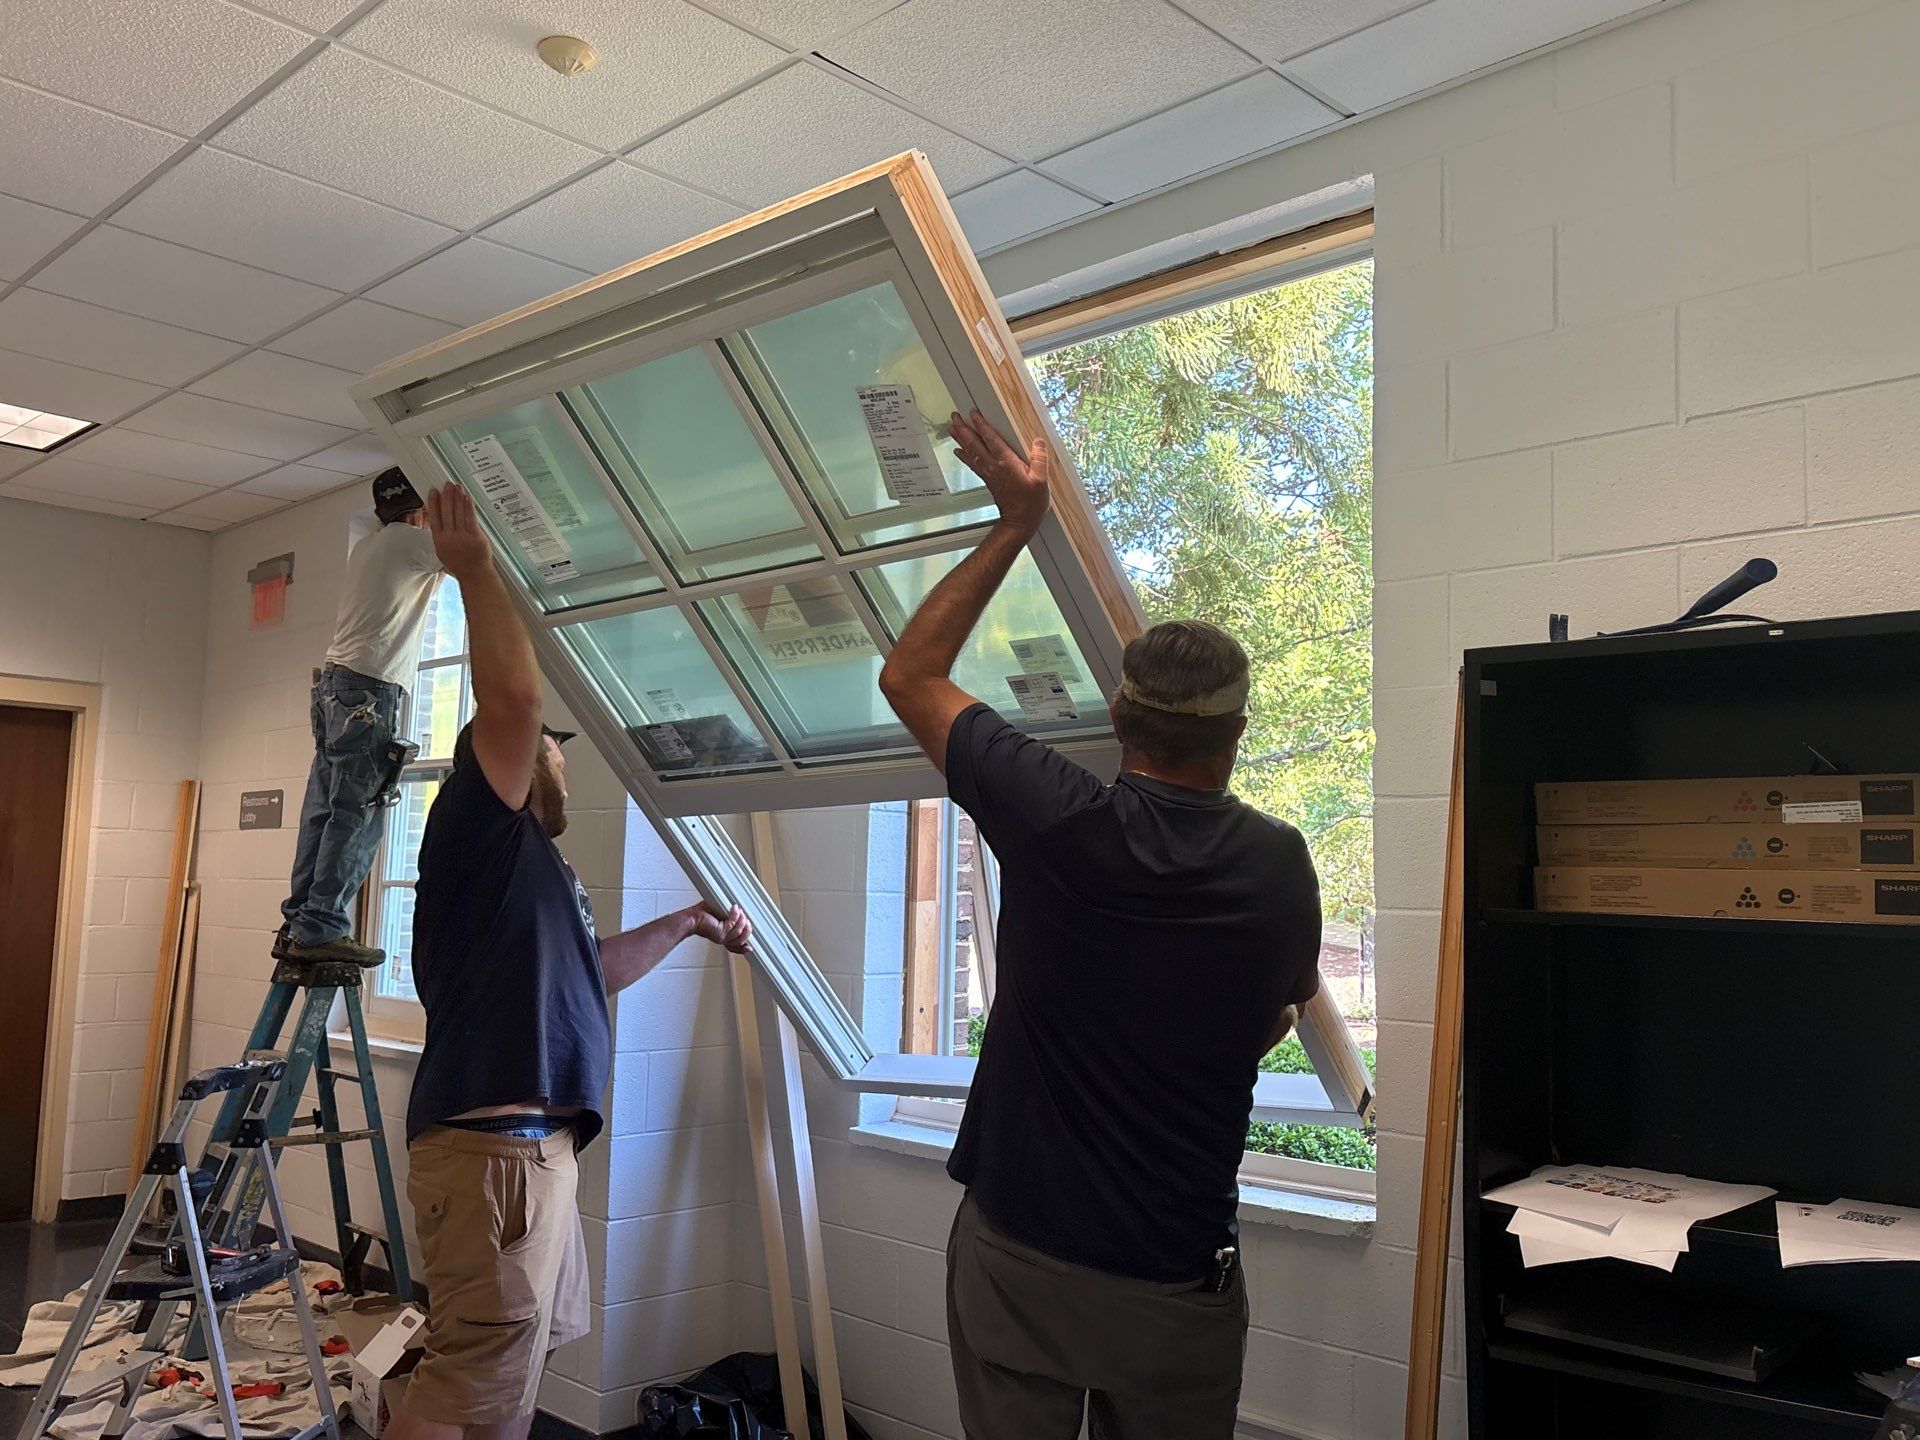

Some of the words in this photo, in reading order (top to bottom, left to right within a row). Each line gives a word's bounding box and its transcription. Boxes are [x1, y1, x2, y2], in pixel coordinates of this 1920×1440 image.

[1866, 785, 1909, 793] SHARP
[242, 796, 269, 807] Restrooms
[241, 812, 257, 824] Lobby
